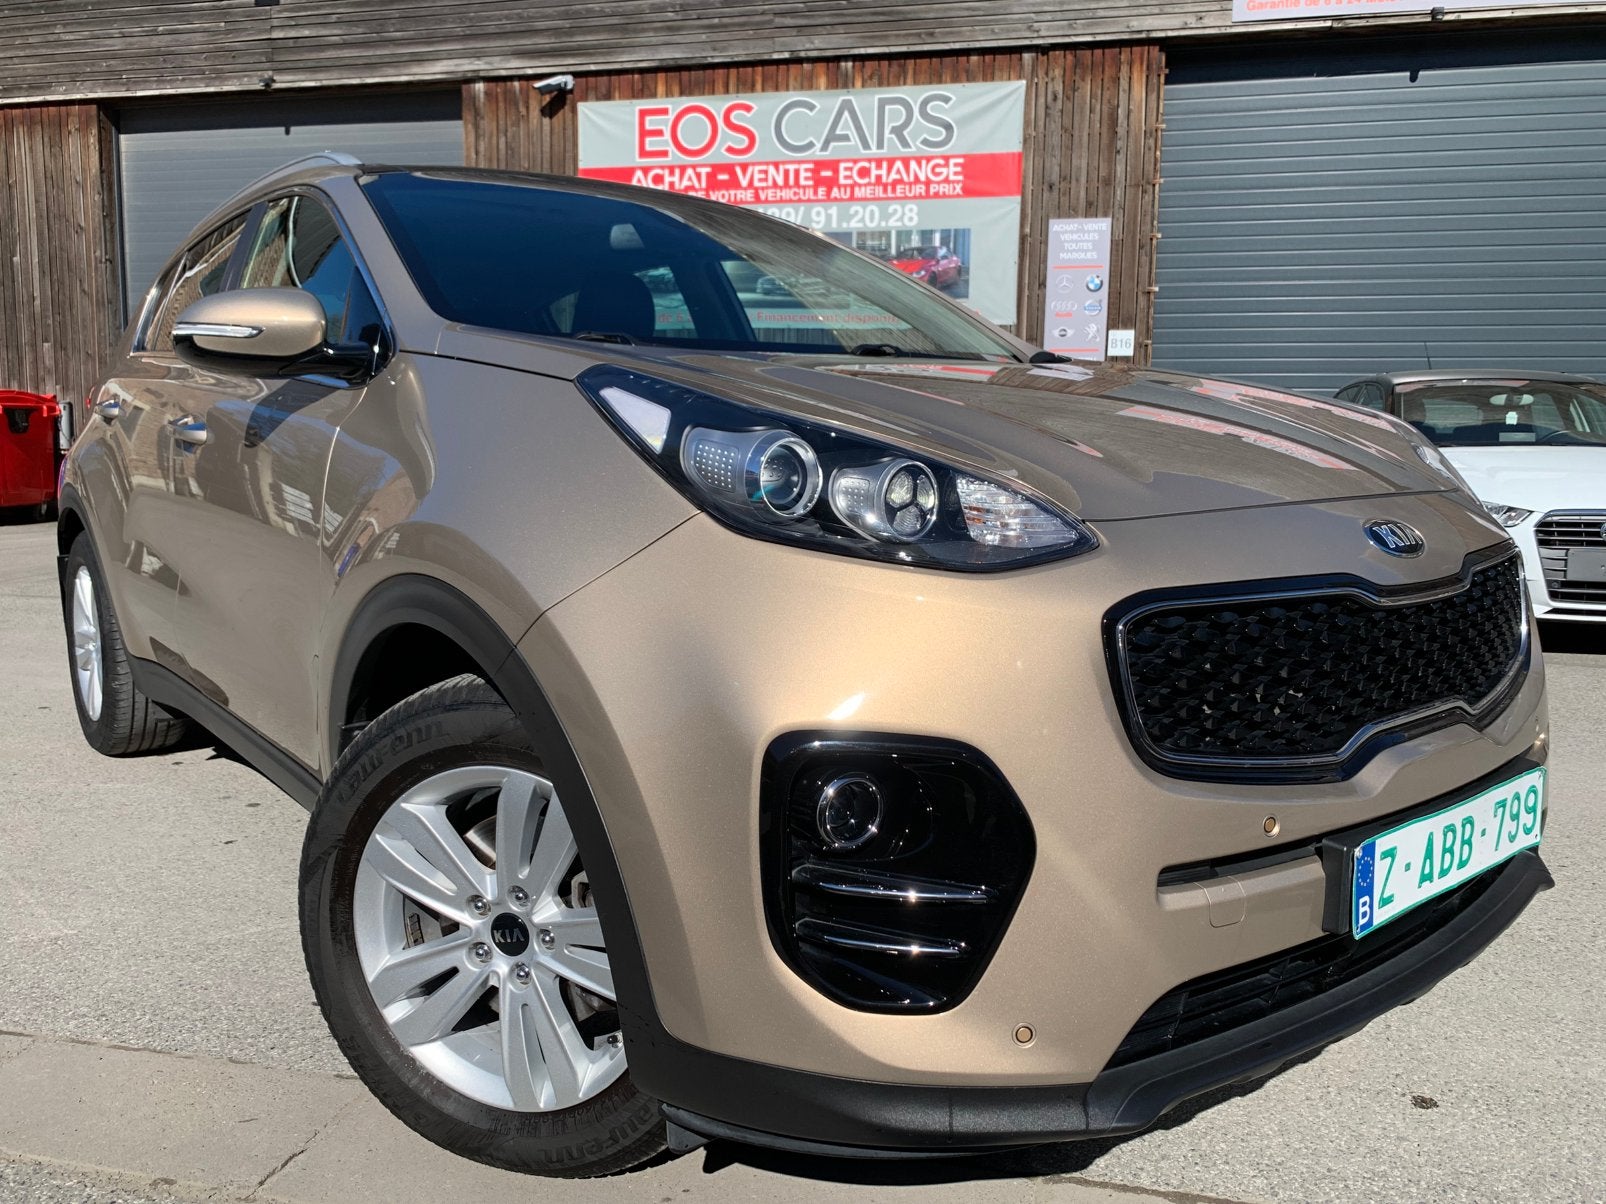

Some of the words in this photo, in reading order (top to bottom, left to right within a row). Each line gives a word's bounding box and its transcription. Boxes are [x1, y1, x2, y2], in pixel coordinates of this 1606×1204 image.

[636, 101, 758, 160] EOS
[772, 92, 956, 154] CARS
[631, 166, 712, 189] ACHAT
[735, 162, 814, 188] VENTE
[839, 158, 964, 185] ECHANGE
[709, 190, 755, 203] VOTRE
[757, 186, 826, 201] VEHICULE
[830, 187, 850, 200] AU
[854, 184, 926, 198] MEILLEUR
[930, 182, 963, 196] PRIX
[811, 204, 919, 229] 91.20.28
[1052, 223, 1078, 231] ACHAT
[1082, 222, 1107, 231] VENTE
[1060, 232, 1099, 240] VEHICULES
[1064, 242, 1093, 250] TOUTES
[1059, 251, 1097, 260] MARQUES
[1110, 338, 1132, 349] B16
[1372, 523, 1423, 549] KIA
[1377, 784, 1540, 910] Z-ABB-799
[1357, 894, 1371, 926] B
[493, 928, 525, 943] KIA
